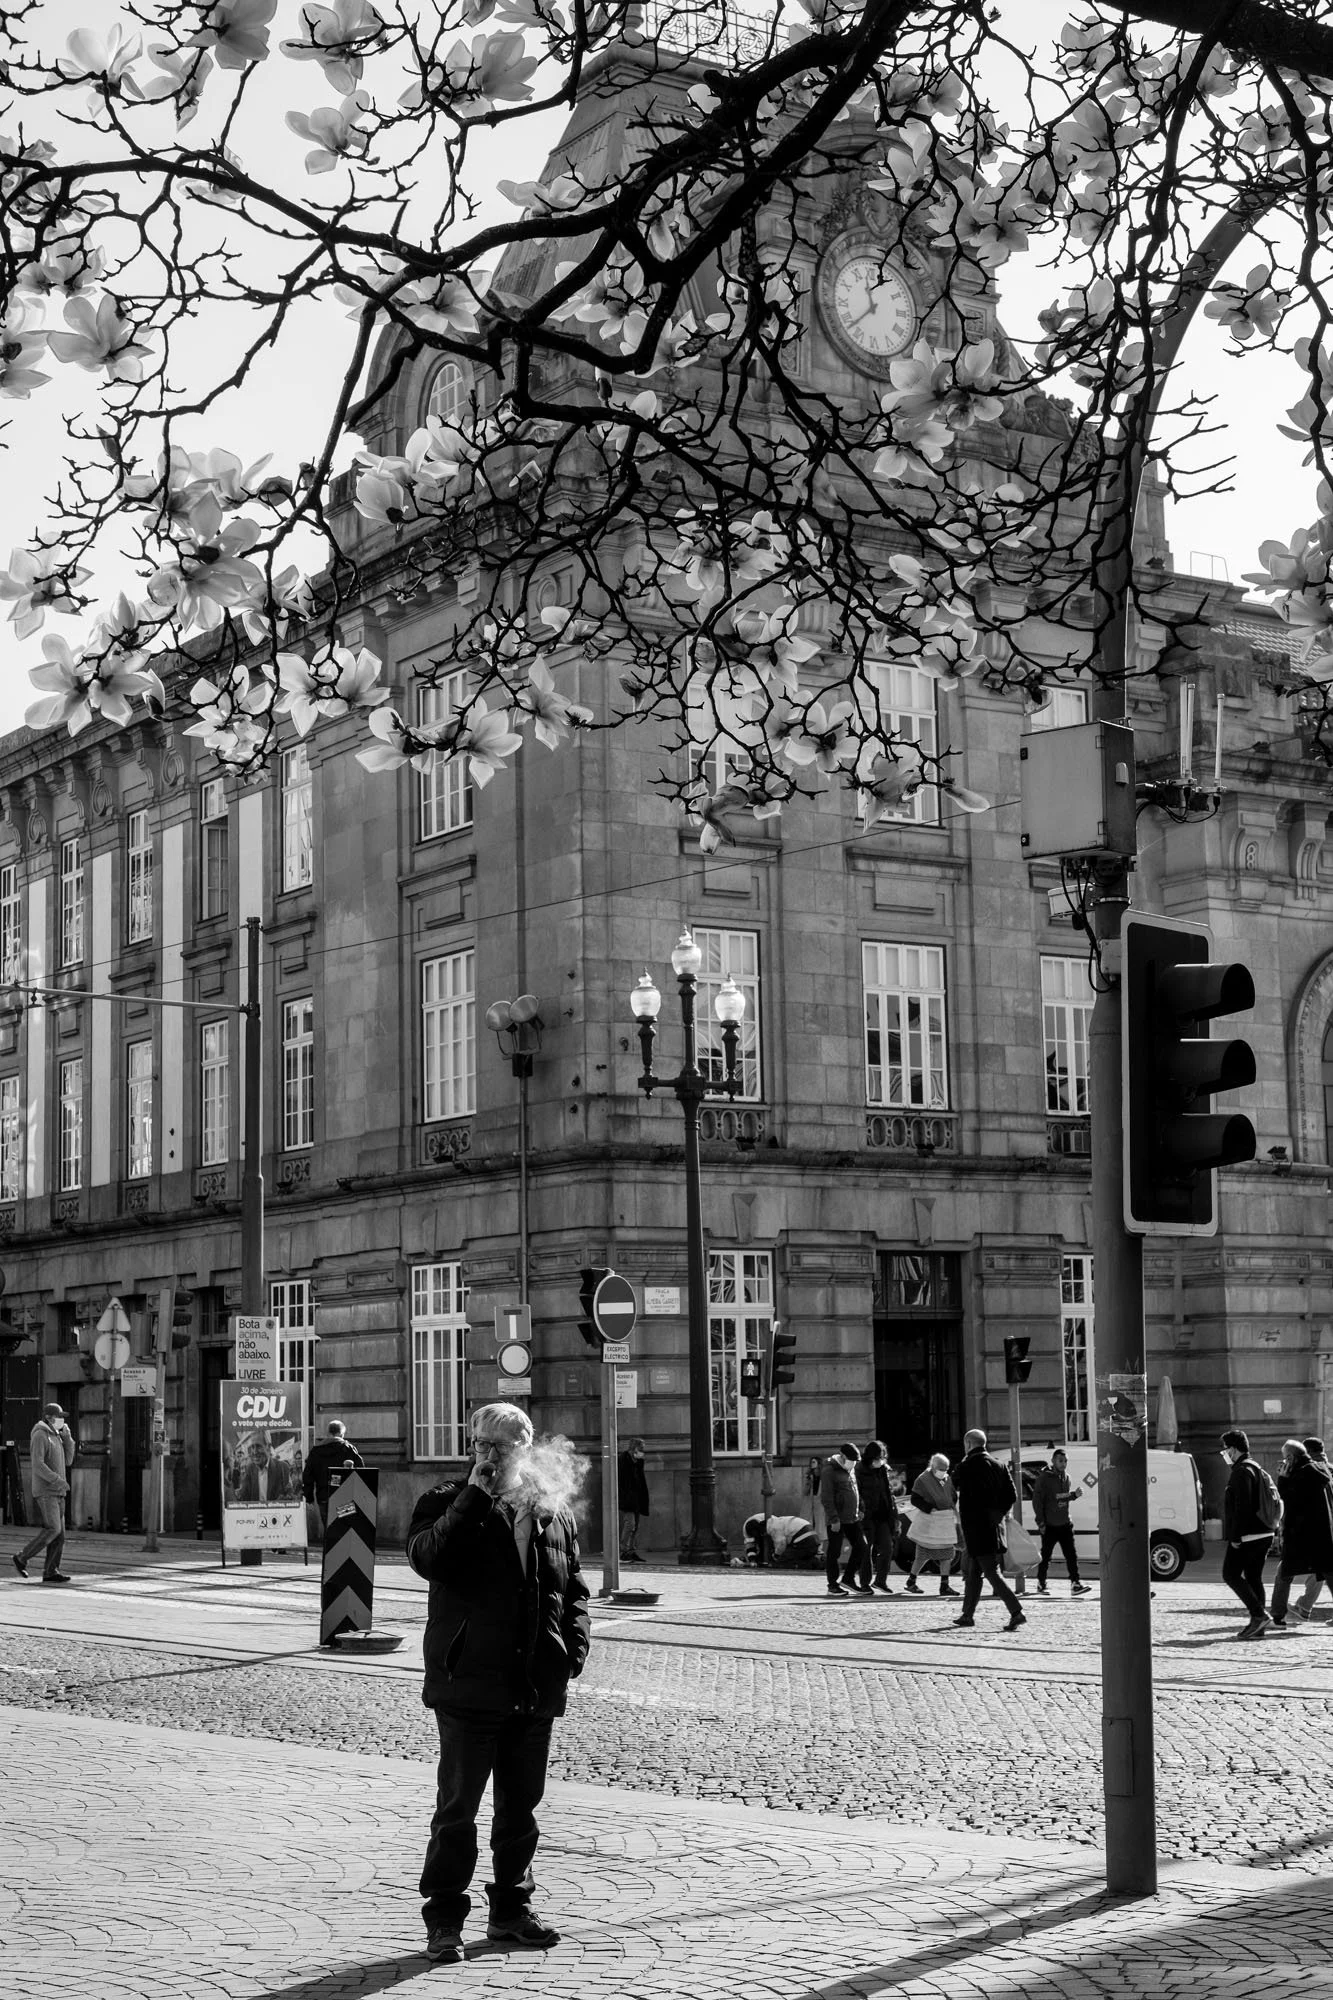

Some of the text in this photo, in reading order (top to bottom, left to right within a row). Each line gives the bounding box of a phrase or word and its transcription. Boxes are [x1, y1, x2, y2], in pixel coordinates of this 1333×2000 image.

[239, 1319, 260, 1328] Bota
[239, 1330, 269, 1341] acima,
[239, 1339, 256, 1349] não
[239, 1349, 271, 1359] abaixo.
[239, 1369, 266, 1379] LIVRE
[236, 1395, 287, 1419] CDU
[255, 1421, 268, 1429] que
[269, 1419, 292, 1427] decide
